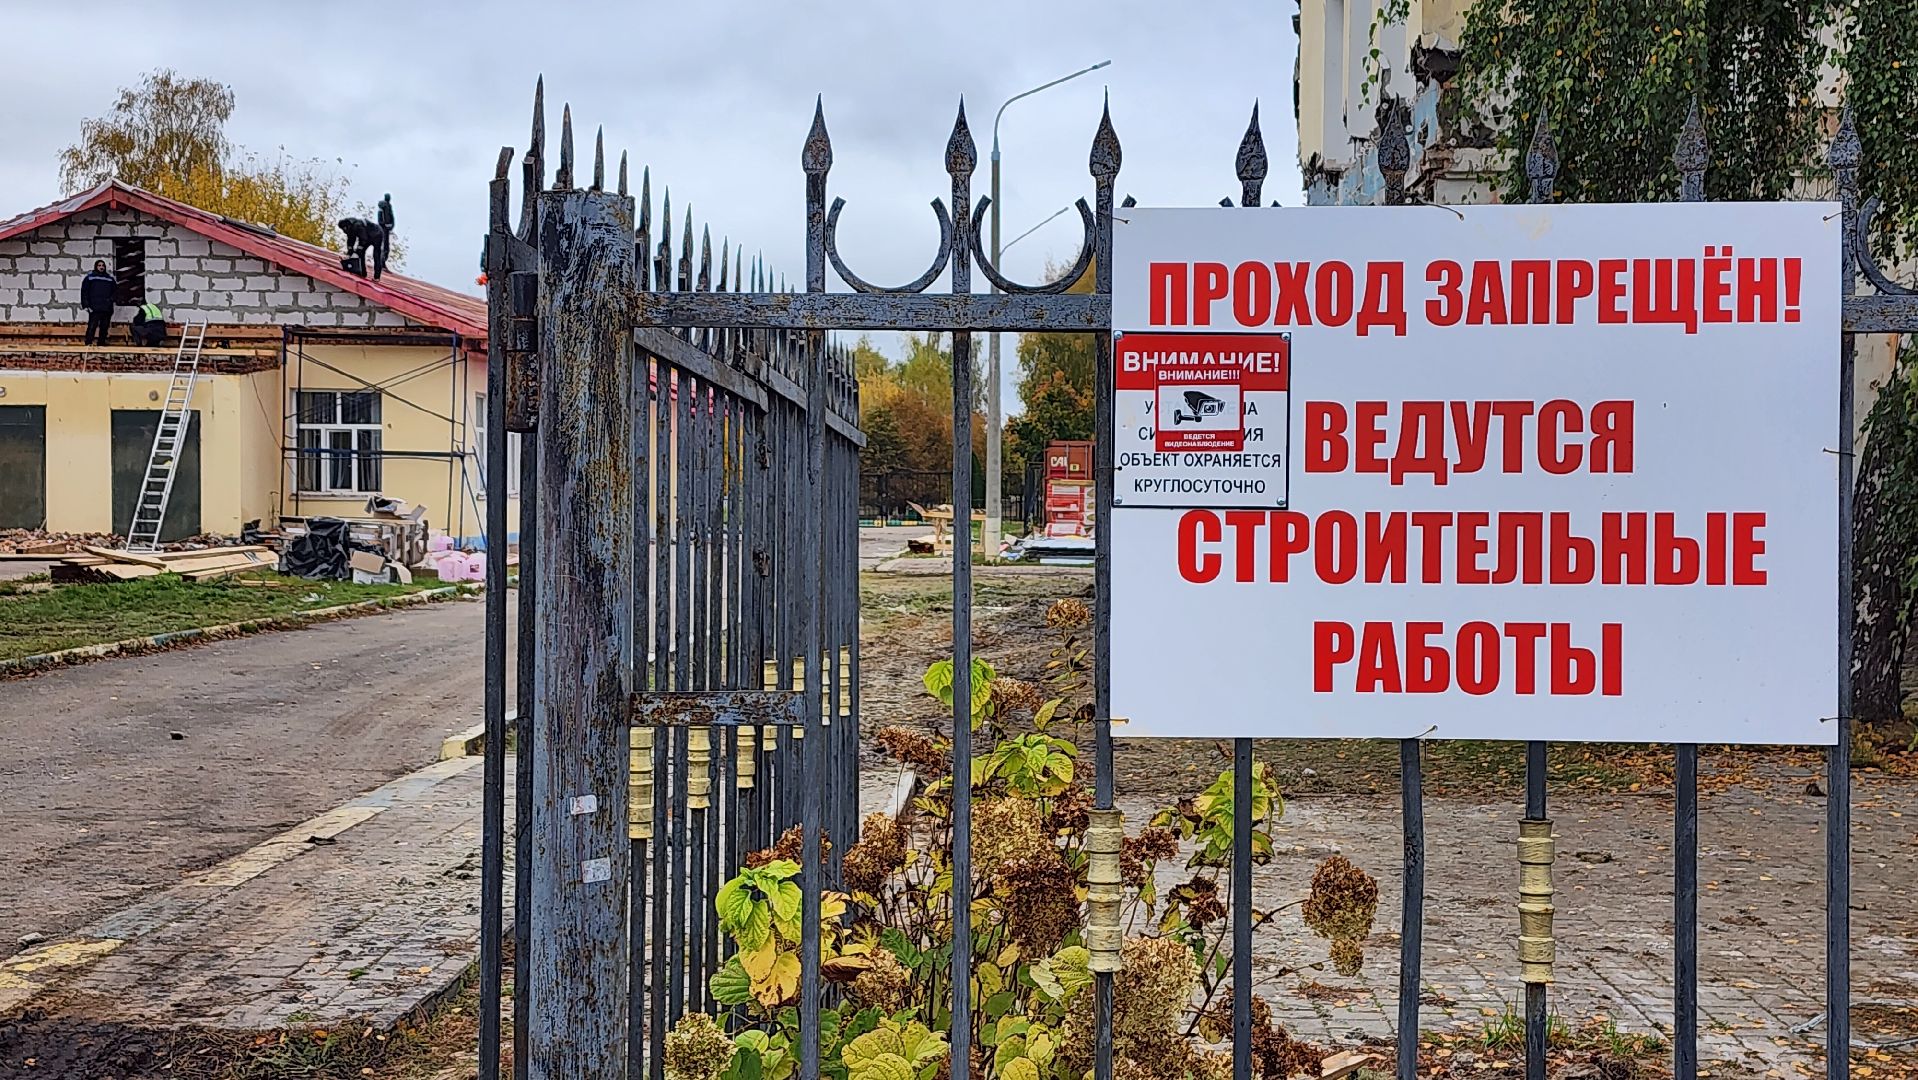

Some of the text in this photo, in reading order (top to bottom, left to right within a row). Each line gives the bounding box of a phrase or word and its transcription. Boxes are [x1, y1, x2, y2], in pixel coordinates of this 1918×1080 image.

[1149, 246, 1802, 336] ПРОХОД ЗАПРЕЩЁН!
[1158, 369, 1240, 381] ВНИМАНИЕ!!!
[1120, 453, 1281, 468] ОБЪЕКТ ОХРАНЯЕТСЯ
[1305, 400, 1634, 485] ВЕДУТСЯ
[1134, 478, 1266, 494] КРУГЛОСУТОЧНО
[1177, 510, 1768, 586] СТРОИТЕЛЬНЫЕ
[1313, 621, 1623, 697] РАБОТЫ
